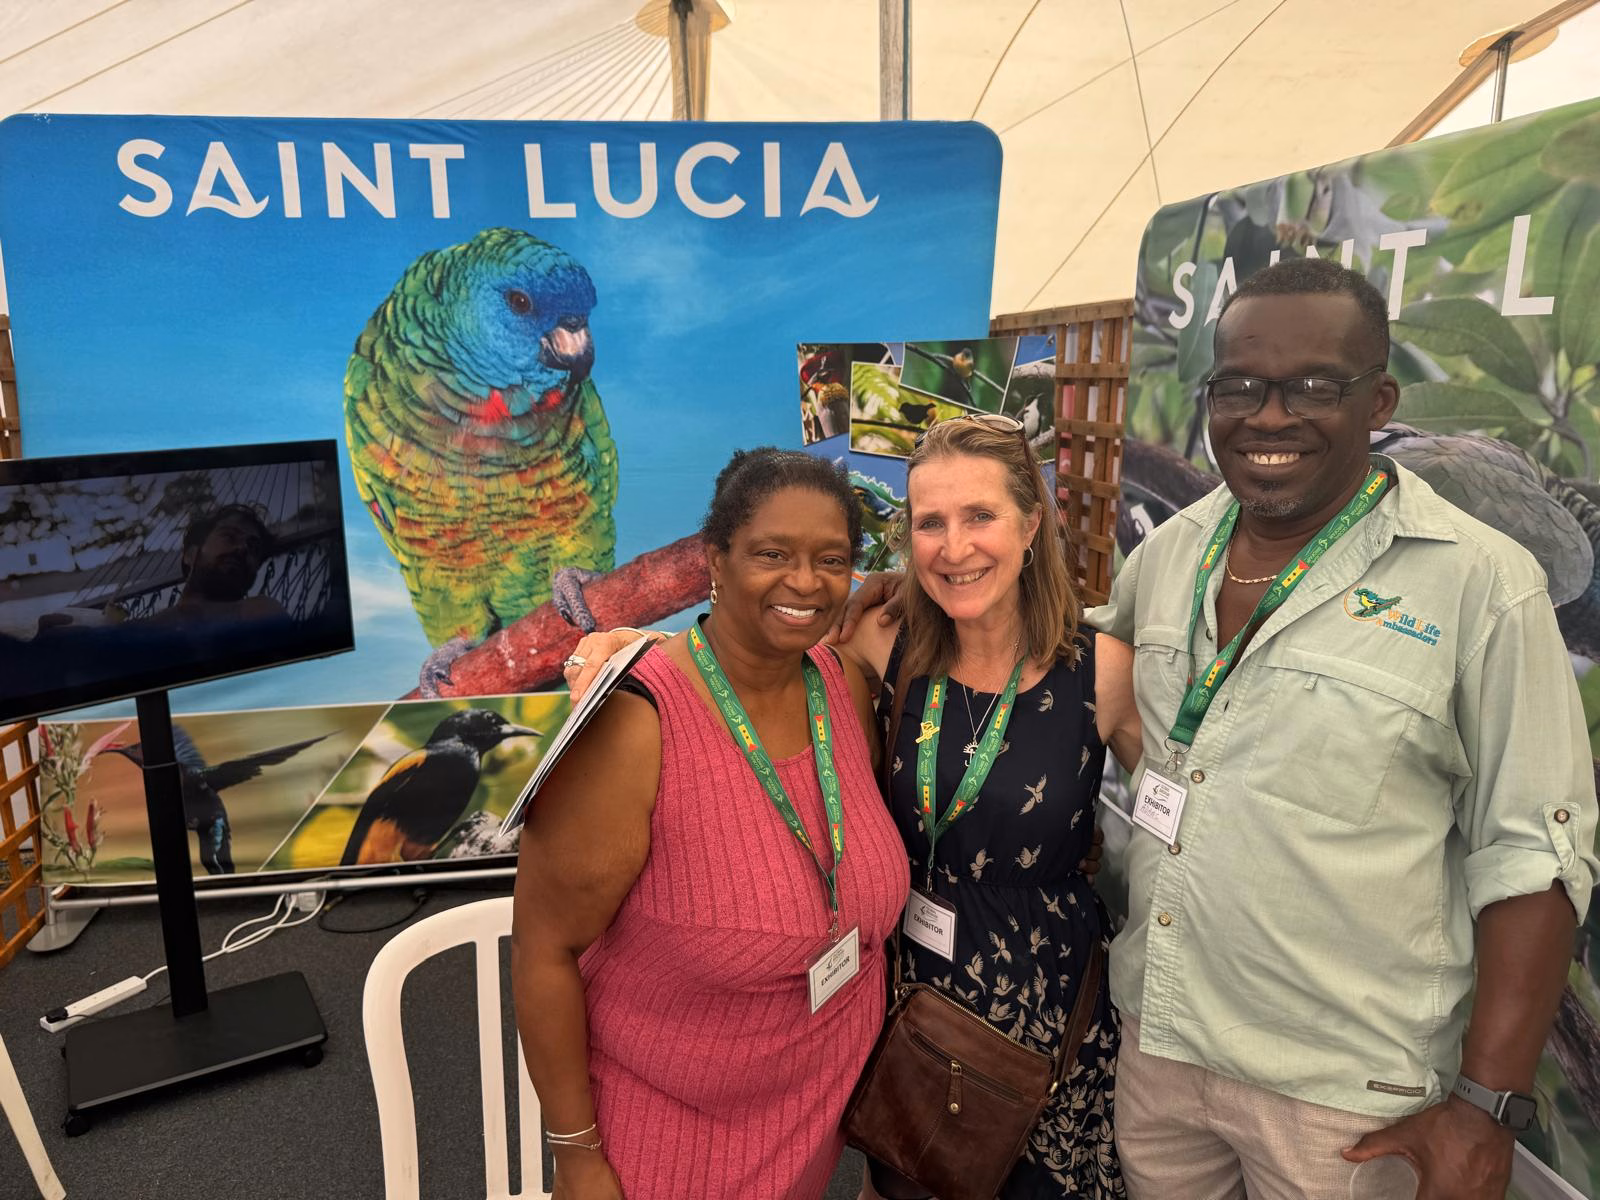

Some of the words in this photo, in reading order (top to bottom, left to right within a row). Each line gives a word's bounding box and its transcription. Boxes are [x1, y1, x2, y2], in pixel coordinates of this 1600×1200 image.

[117, 139, 466, 219] SAINT
[524, 139, 880, 219] LUCIA
[1144, 795, 1171, 817] EXHIBITOR
[913, 913, 944, 936] EXHIBITOR
[820, 955, 850, 987] EXHIBITOR
